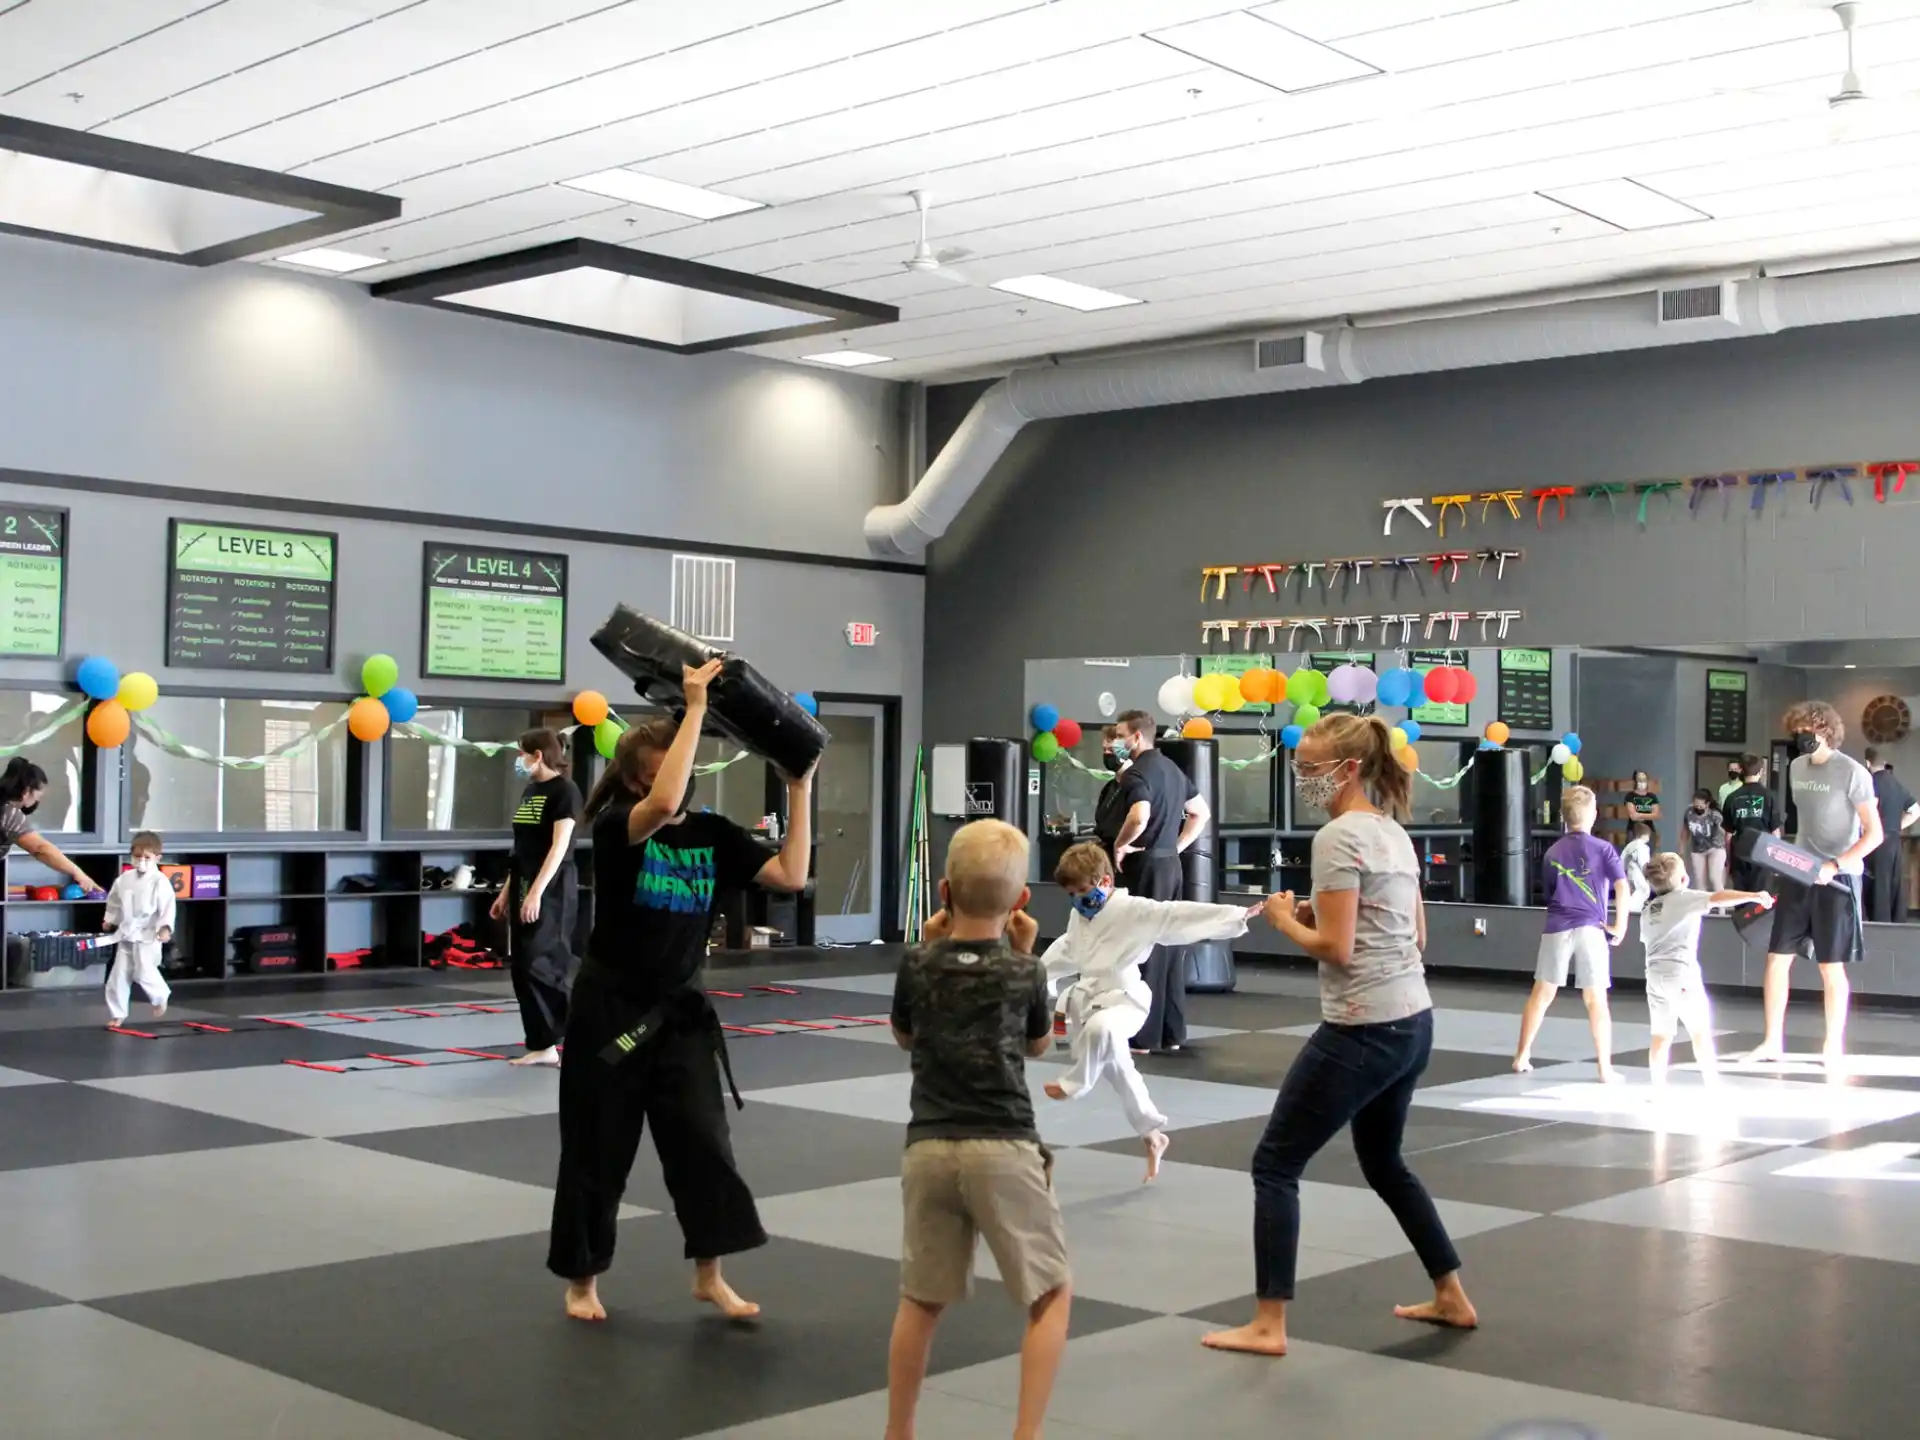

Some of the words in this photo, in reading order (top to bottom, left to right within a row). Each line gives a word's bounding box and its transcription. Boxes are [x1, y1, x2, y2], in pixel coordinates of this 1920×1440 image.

[4, 516, 17, 535] 2
[22, 541, 51, 552] LEADER
[218, 536, 278, 556] LEVEL
[283, 543, 293, 558] 3
[466, 556, 519, 577] LEVEL
[522, 562, 532, 578] 4
[180, 574, 217, 585] ROTATION
[234, 578, 269, 588] ROTATION
[285, 582, 320, 593] ROTATION
[169, 871, 185, 892] 6
